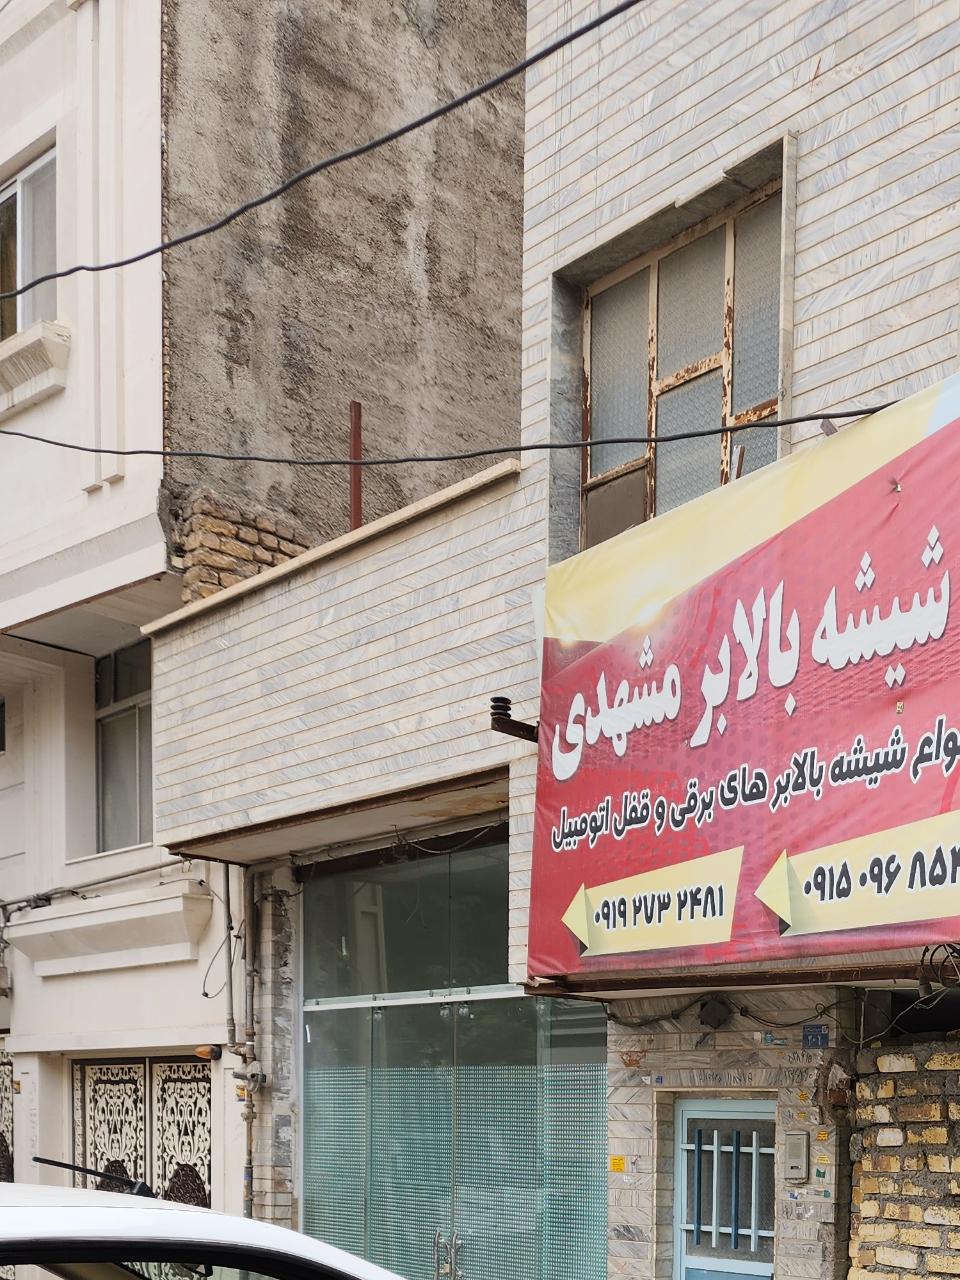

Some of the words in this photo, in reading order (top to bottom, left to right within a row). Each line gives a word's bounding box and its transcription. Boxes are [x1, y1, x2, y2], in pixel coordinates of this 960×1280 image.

[811, 524, 951, 690] شیشه
[689, 578, 802, 749] بالابر
[551, 634, 683, 782] مشهدی
[770, 747, 825, 811] بالابر
[830, 726, 908, 789] شیشه
[612, 788, 651, 838] قفل
[669, 778, 716, 829] برقی
[719, 764, 768, 810] های
[551, 796, 612, 852] اتومبیل
[654, 796, 667, 836] و
[594, 895, 627, 930] ۰۹۱۹
[631, 893, 671, 927] ۲۷۳
[676, 883, 725, 921] ۲۴۸۱
[803, 859, 853, 903] ۰۹۱۵
[858, 858, 901, 898] ۰۹۶
